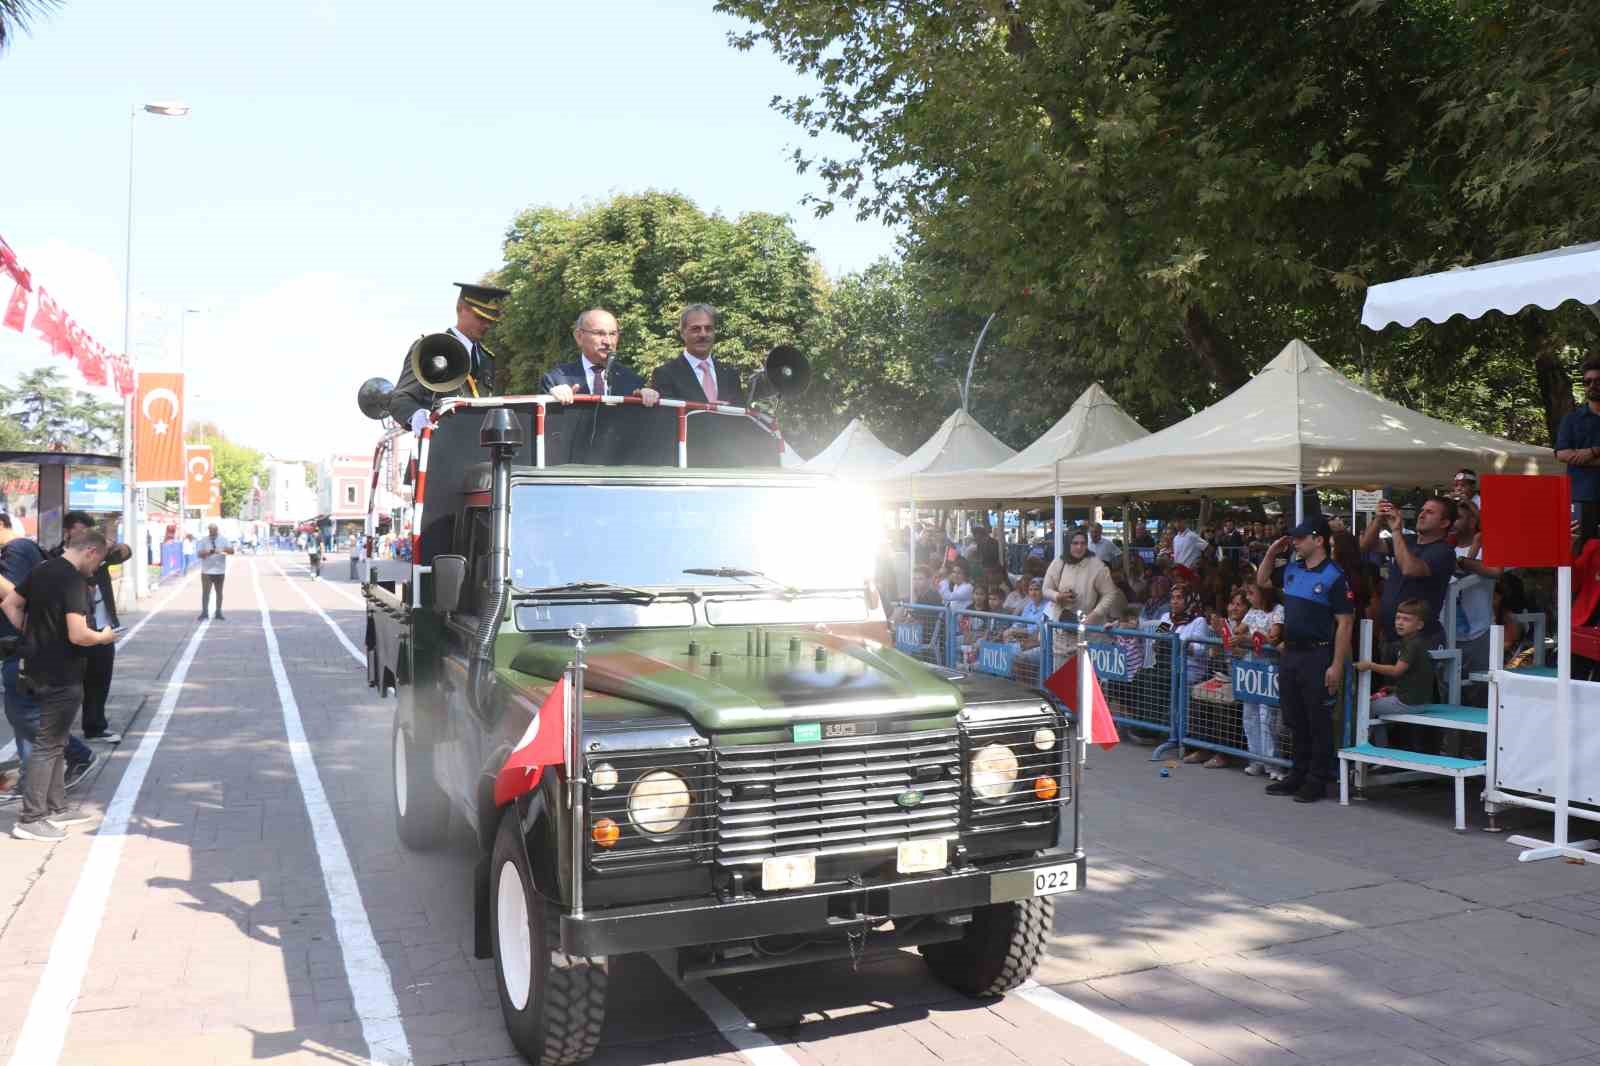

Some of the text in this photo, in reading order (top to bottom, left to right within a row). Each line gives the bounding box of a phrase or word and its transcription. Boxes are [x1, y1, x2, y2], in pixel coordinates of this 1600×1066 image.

[983, 647, 1008, 671] POLİS
[1089, 647, 1126, 676] POLİS
[1235, 665, 1280, 699] POLİS
[1035, 870, 1069, 890] 022
